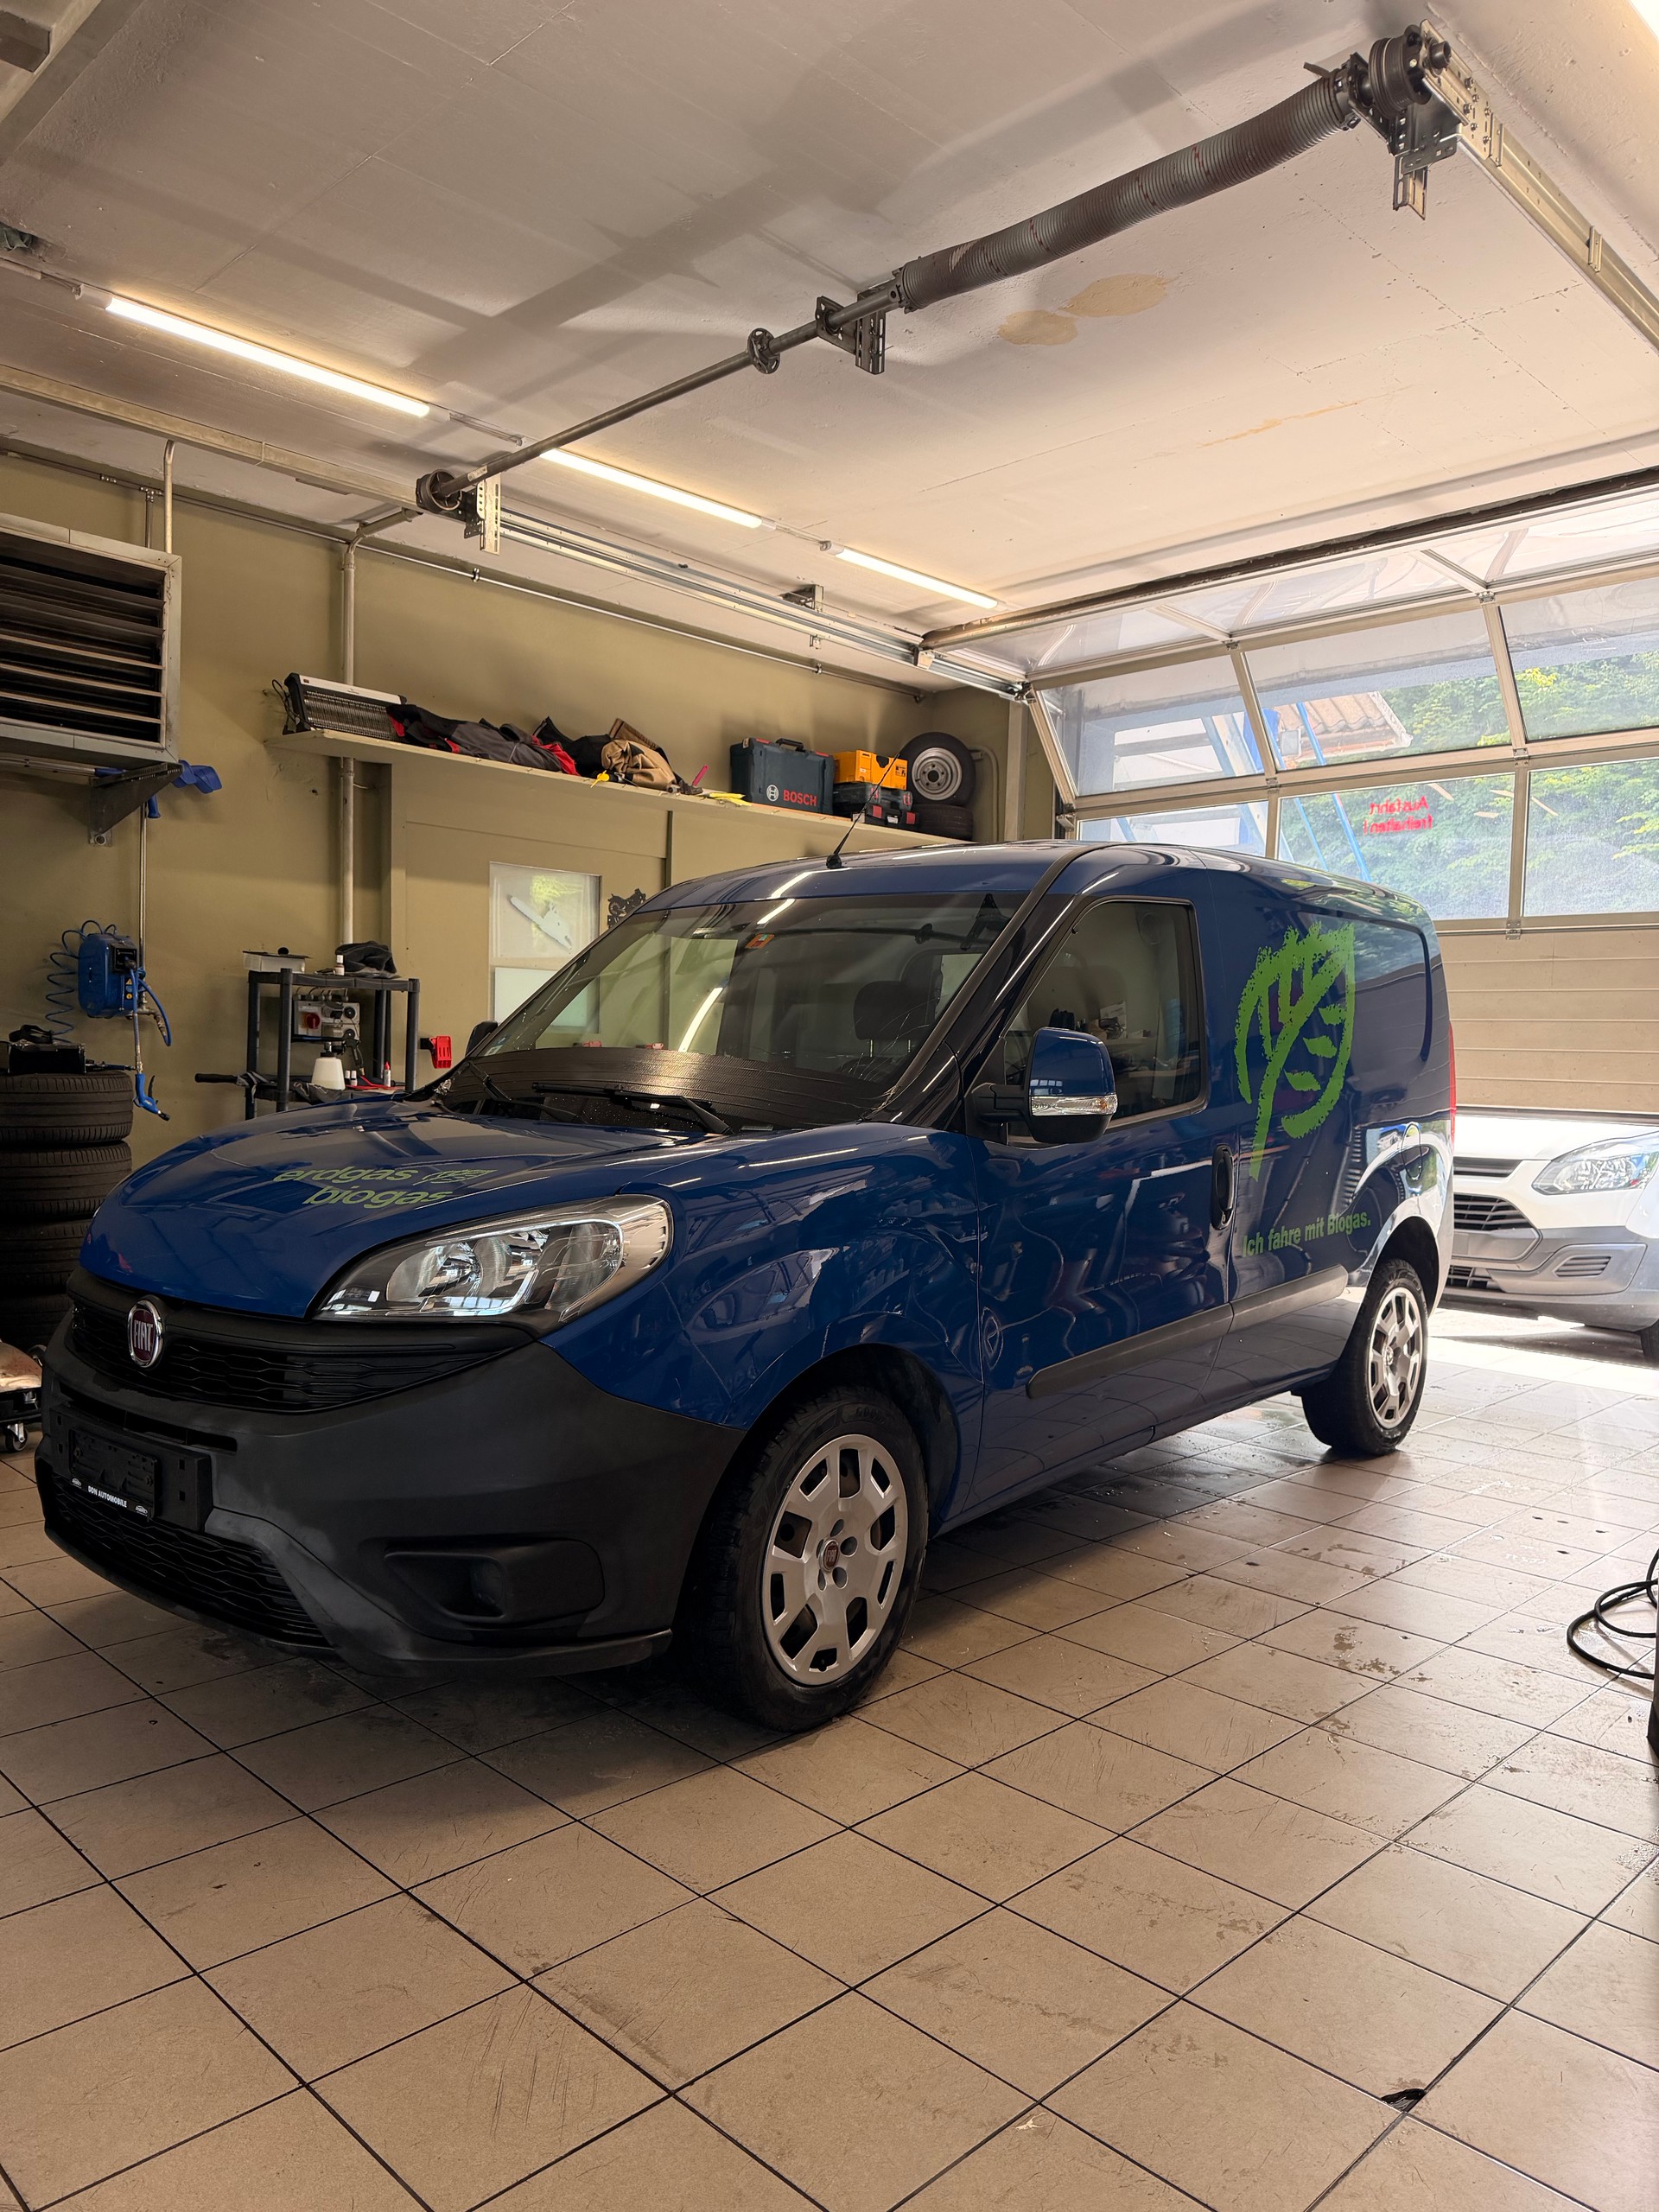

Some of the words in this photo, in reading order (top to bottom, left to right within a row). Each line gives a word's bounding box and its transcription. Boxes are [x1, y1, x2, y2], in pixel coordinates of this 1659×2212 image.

[783, 789, 817, 806] BOSCH
[272, 1166, 418, 1183] erdgas
[302, 1185, 454, 1209] biogas
[1243, 1232, 1264, 1257] Ich
[1268, 1225, 1300, 1250] fahre
[1305, 1217, 1325, 1241] mit
[1327, 1211, 1371, 1235] Biogas.
[134, 1319, 154, 1352] FIAT
